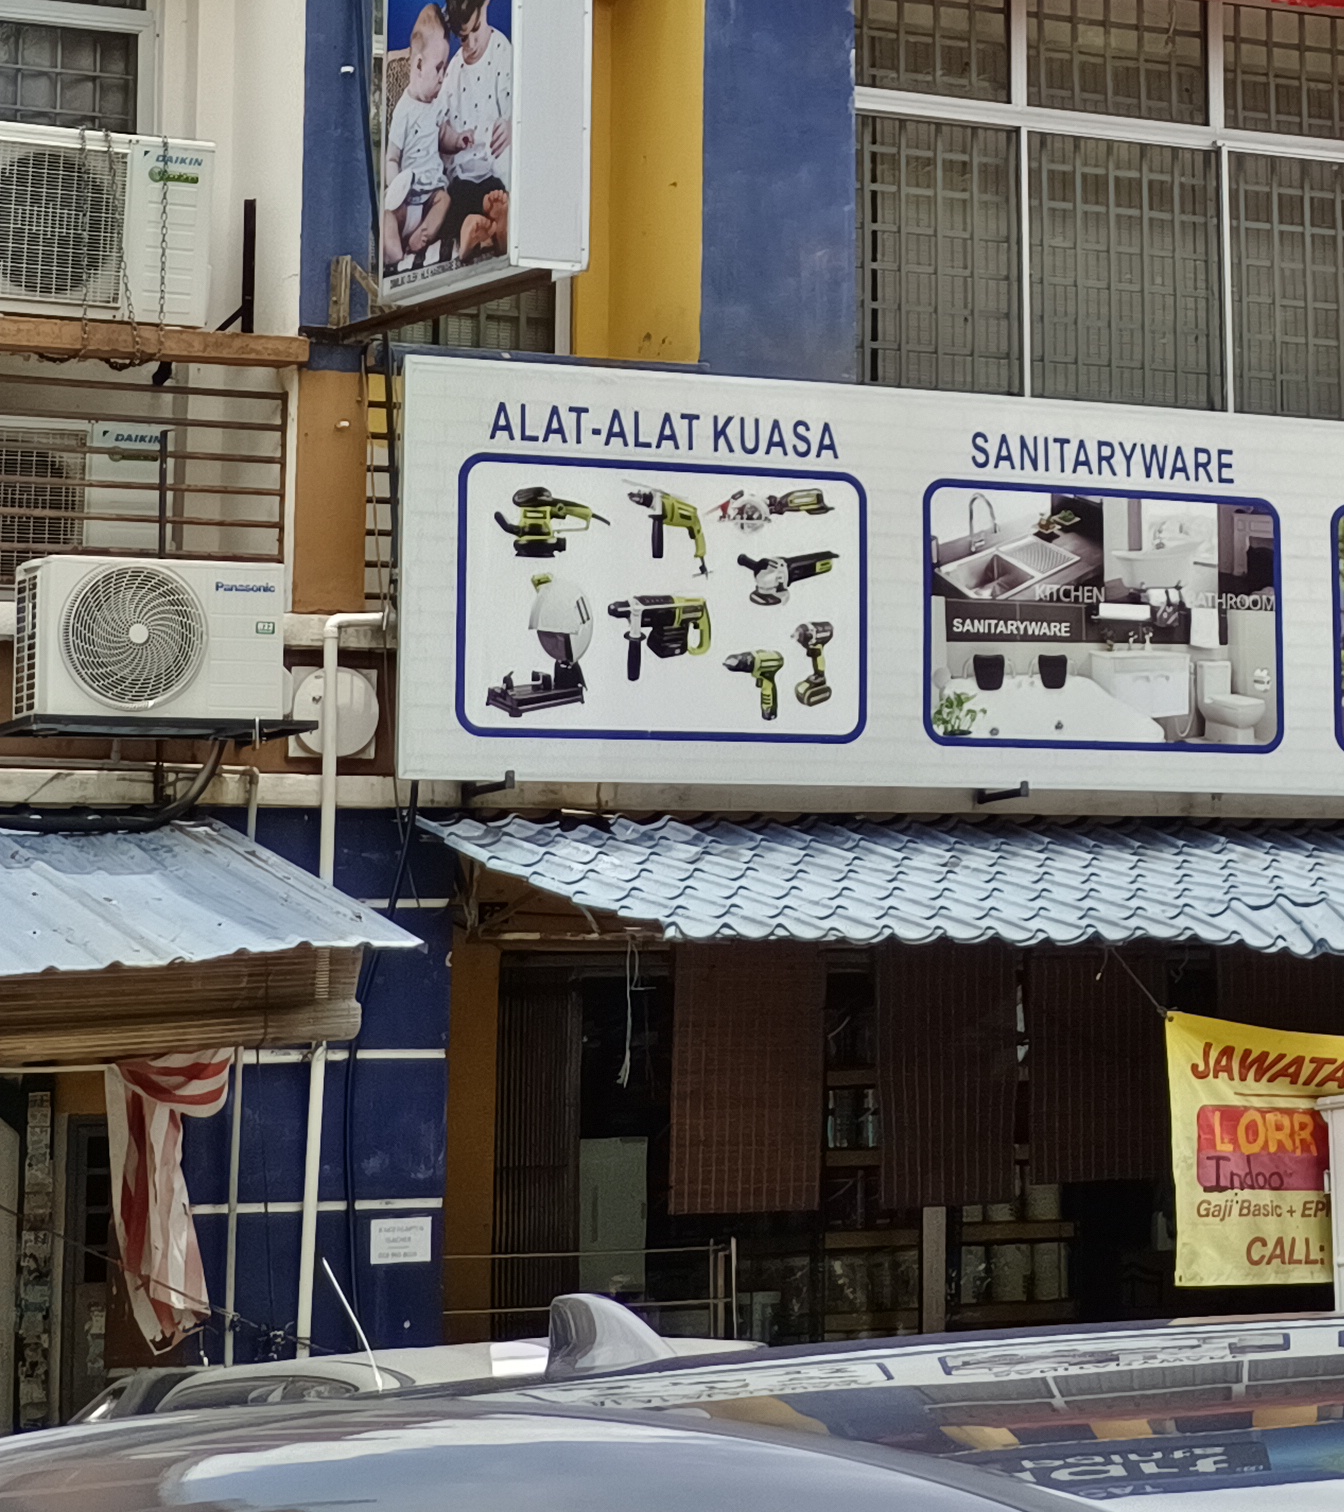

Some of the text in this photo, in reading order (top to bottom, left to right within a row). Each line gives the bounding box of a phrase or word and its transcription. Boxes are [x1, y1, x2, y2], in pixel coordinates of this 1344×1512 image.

[156, 154, 203, 166] DAIKIN
[489, 402, 839, 459] ALAT-ALAT KUASA
[970, 432, 1235, 484] SANITARYWARE
[215, 581, 276, 593] Panasonic
[1035, 584, 1105, 604] KITCHEN
[952, 618, 1071, 638] SANITARYWARE
[1196, 1199, 1234, 1222] Gaji
[1238, 1199, 1282, 1218] Basic
[1246, 1236, 1325, 1266] CALL:
